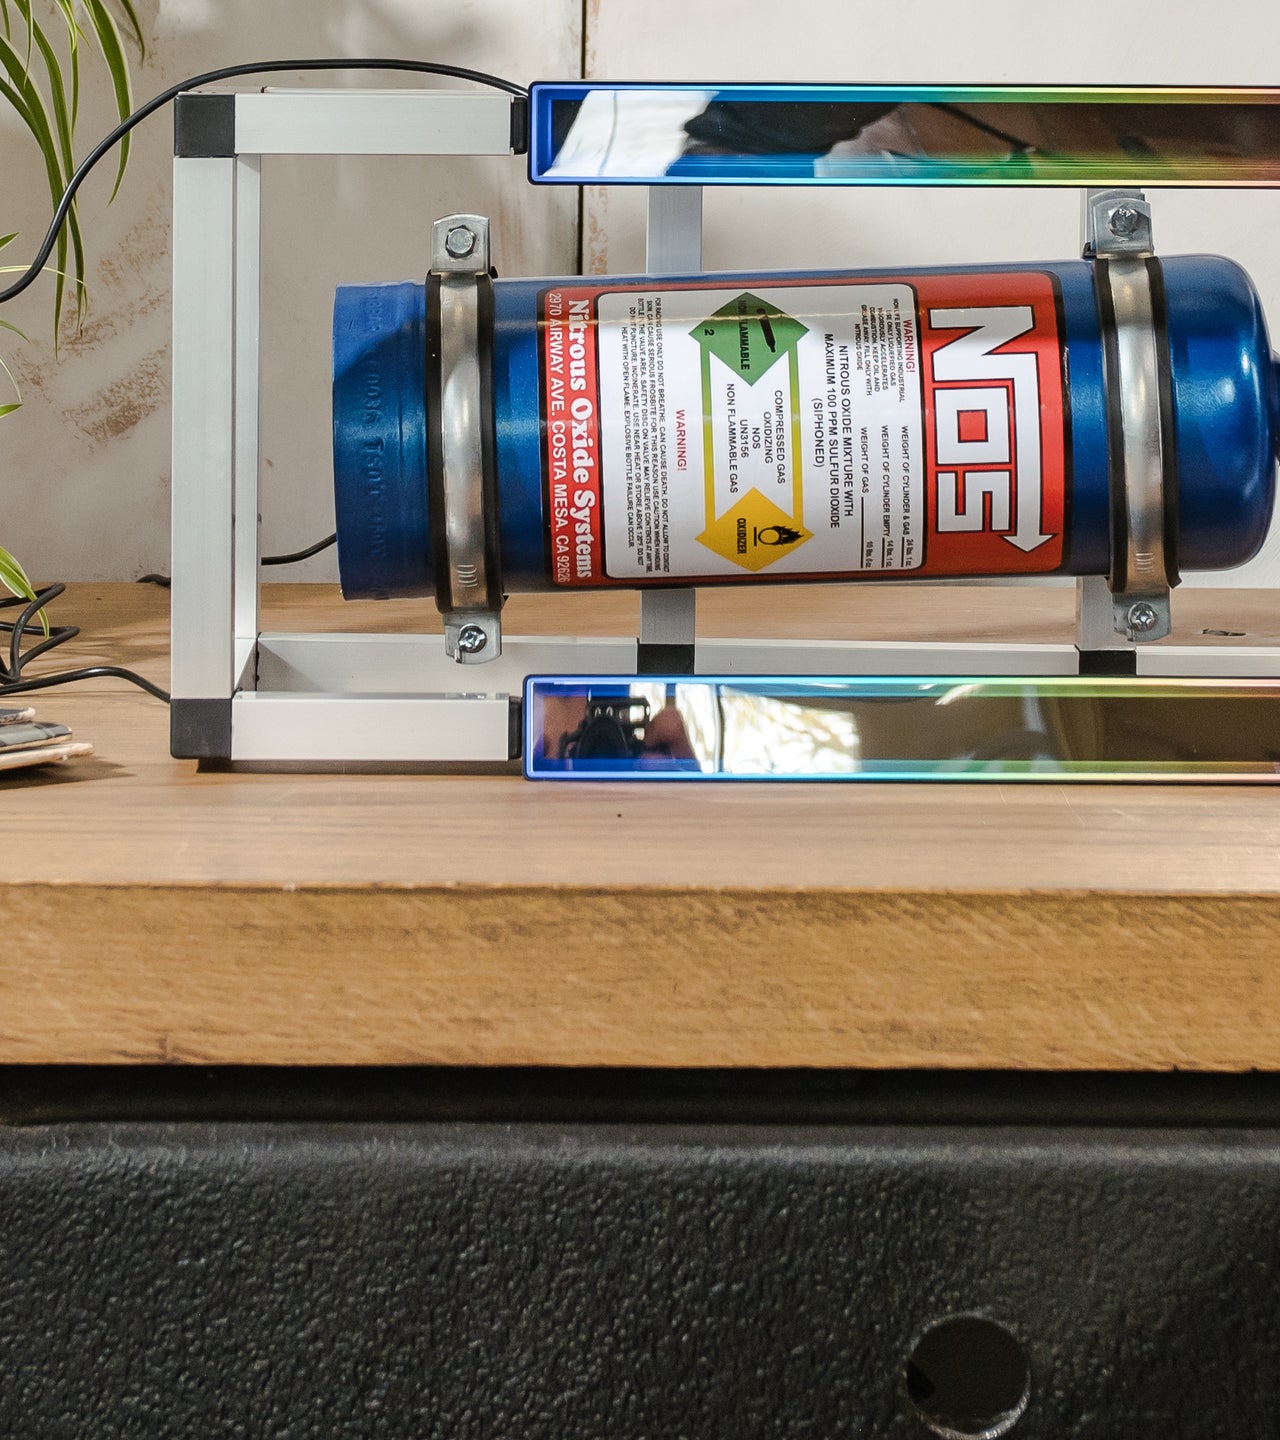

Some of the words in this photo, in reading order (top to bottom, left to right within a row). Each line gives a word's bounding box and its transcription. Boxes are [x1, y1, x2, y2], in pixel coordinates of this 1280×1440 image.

[548, 293, 562, 315] 2970
[549, 319, 564, 373] AIRWAY
[567, 299, 590, 391] Nitrous
[647, 326, 655, 347] CAUSE
[895, 322, 903, 361] SUPPORTING
[903, 320, 915, 373] WARNING!
[622, 362, 630, 381] OPEN
[648, 348, 656, 378] SERIOUS
[825, 334, 836, 384] MAXIMUM
[839, 346, 850, 395] NITROUS
[880, 344, 888, 391] ACCELERATES
[551, 378, 565, 416] AVE.
[640, 380, 648, 406] SAFETY
[727, 384, 736, 406] NON
[827, 388, 837, 407] 100
[897, 362, 905, 403] INDUSTRIAL
[624, 410, 632, 453] EXPLOSIVE
[642, 428, 649, 439] ON
[657, 361, 664, 370] DO
[661, 498, 668, 508] DO
[775, 390, 785, 461] COMPRESSED
[811, 398, 824, 468] (SIPHONED)
[828, 411, 838, 436] PPM
[841, 399, 851, 434] OXIDE
[928, 305, 1058, 553] NOS
[552, 420, 567, 480] COSTA
[571, 398, 595, 483] Oxide
[642, 441, 650, 464] VALVE
[676, 410, 686, 470] WARNING!
[727, 409, 737, 471] FLAMMABLE
[740, 420, 749, 458] UN3156
[752, 428, 760, 449] NOS
[764, 412, 773, 464] OXIDIZING
[861, 427, 869, 462] WEIGHT
[635, 473, 641, 483] OR
[776, 464, 785, 484] GAS
[828, 440, 839, 485] SULFUR
[842, 438, 853, 488] MIXTURE
[861, 463, 869, 474] OF
[882, 462, 889, 472] OF
[902, 462, 909, 473] OF
[729, 473, 738, 493] GAS
[882, 474, 890, 512] CYLINDER
[902, 475, 910, 514] CYLINDER
[829, 488, 840, 528] DIOXIDE
[843, 491, 853, 517] WITH
[556, 535, 569, 554] CA
[570, 490, 597, 578] Systems
[737, 518, 747, 554] OXIDIZER
[882, 515, 890, 536] EMPTY
[556, 556, 570, 583] 92626
